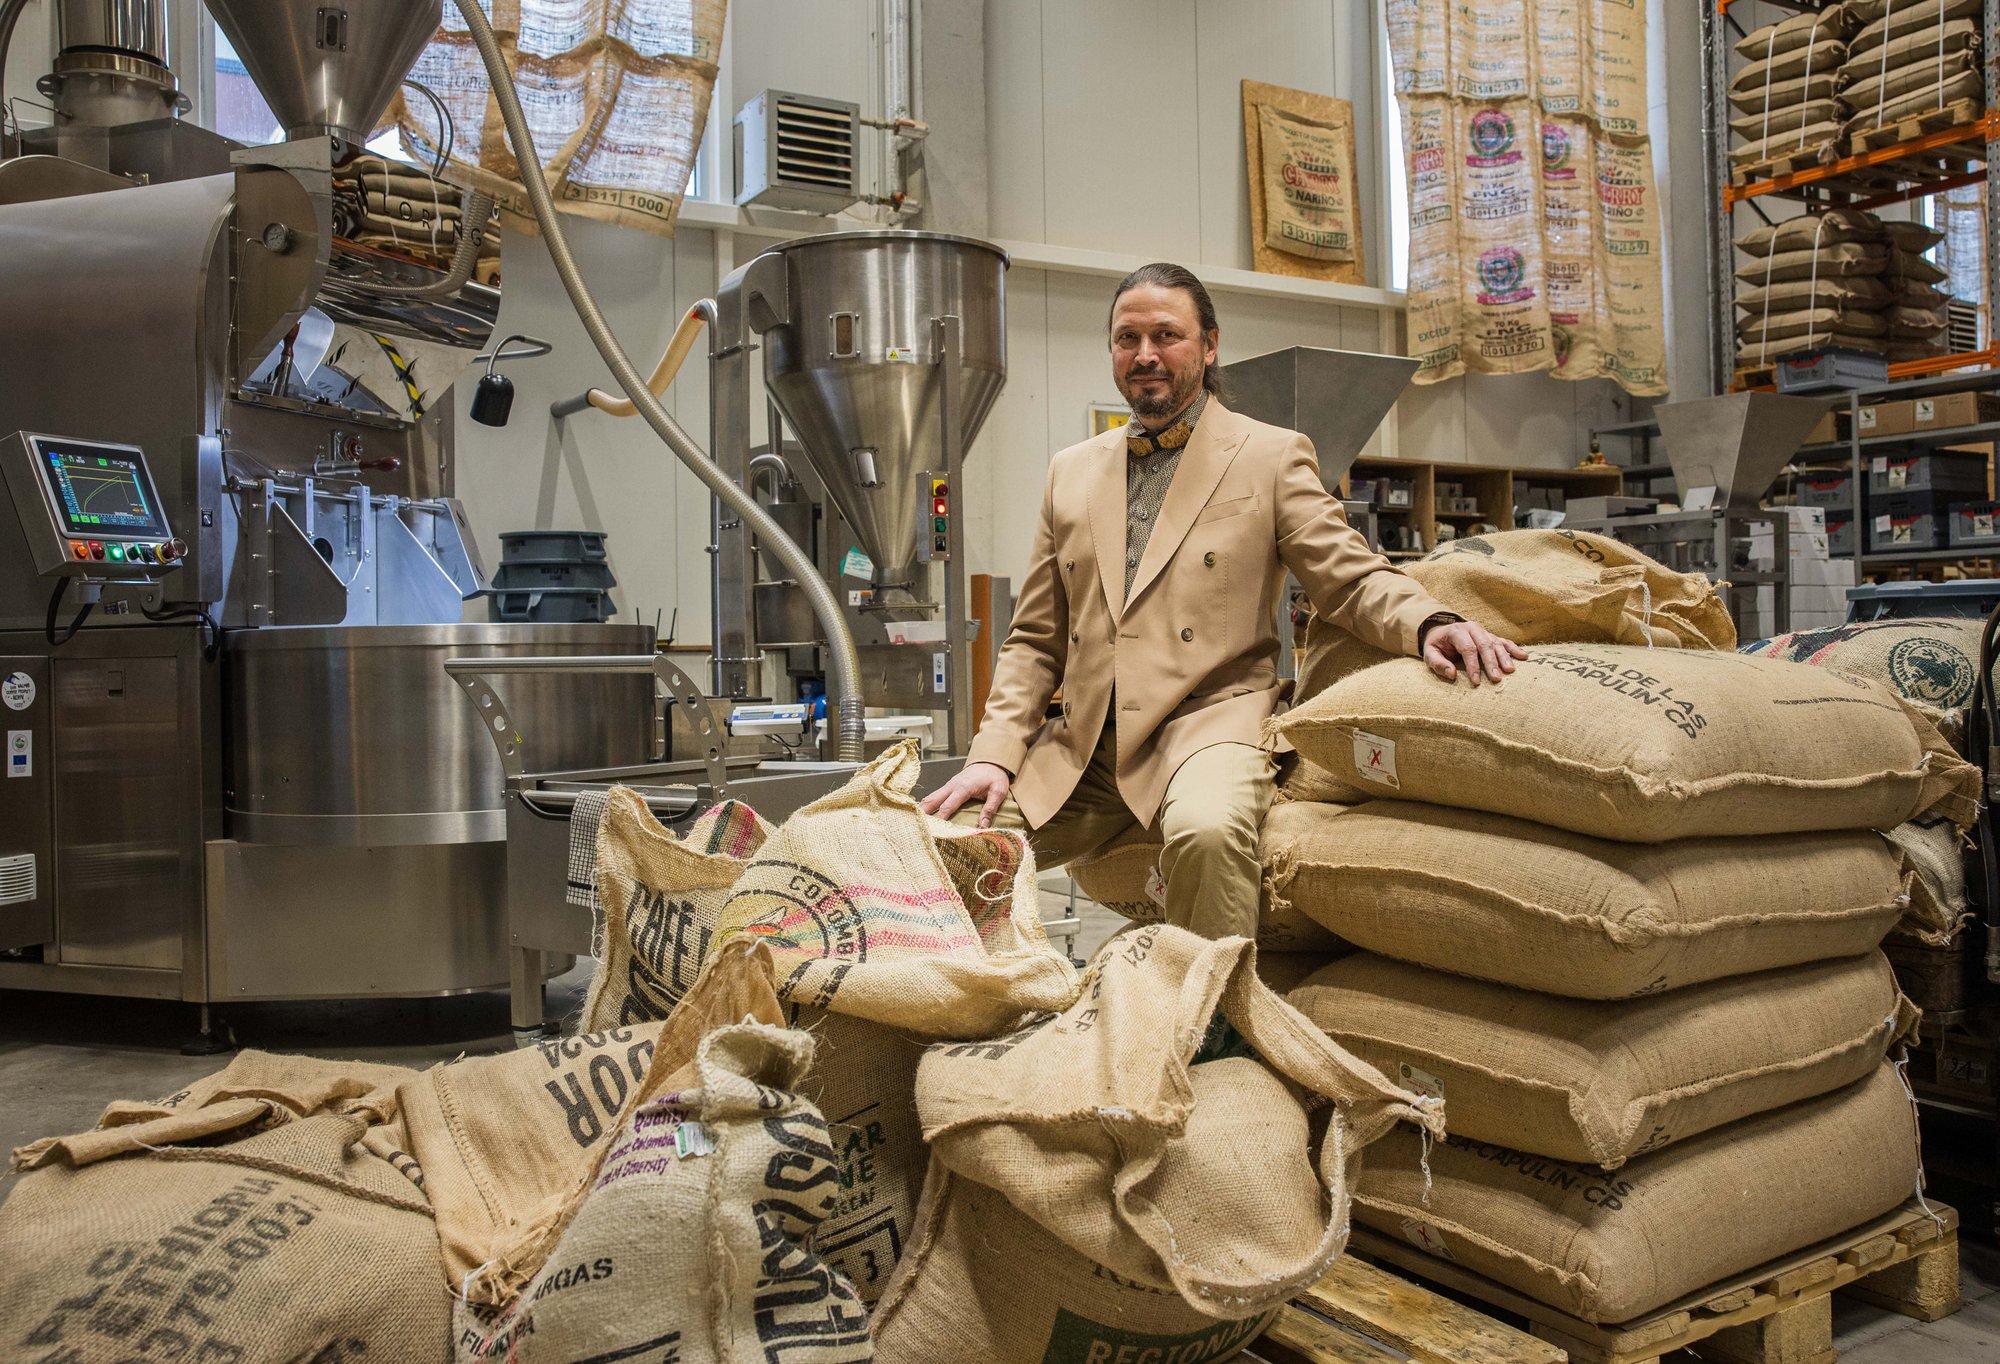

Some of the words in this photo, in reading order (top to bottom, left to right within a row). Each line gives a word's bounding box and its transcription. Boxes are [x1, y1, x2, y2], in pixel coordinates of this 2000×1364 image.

[628, 195, 664, 213] 1000
[1620, 668, 1661, 690] DE
[1659, 687, 1707, 730] LAS
